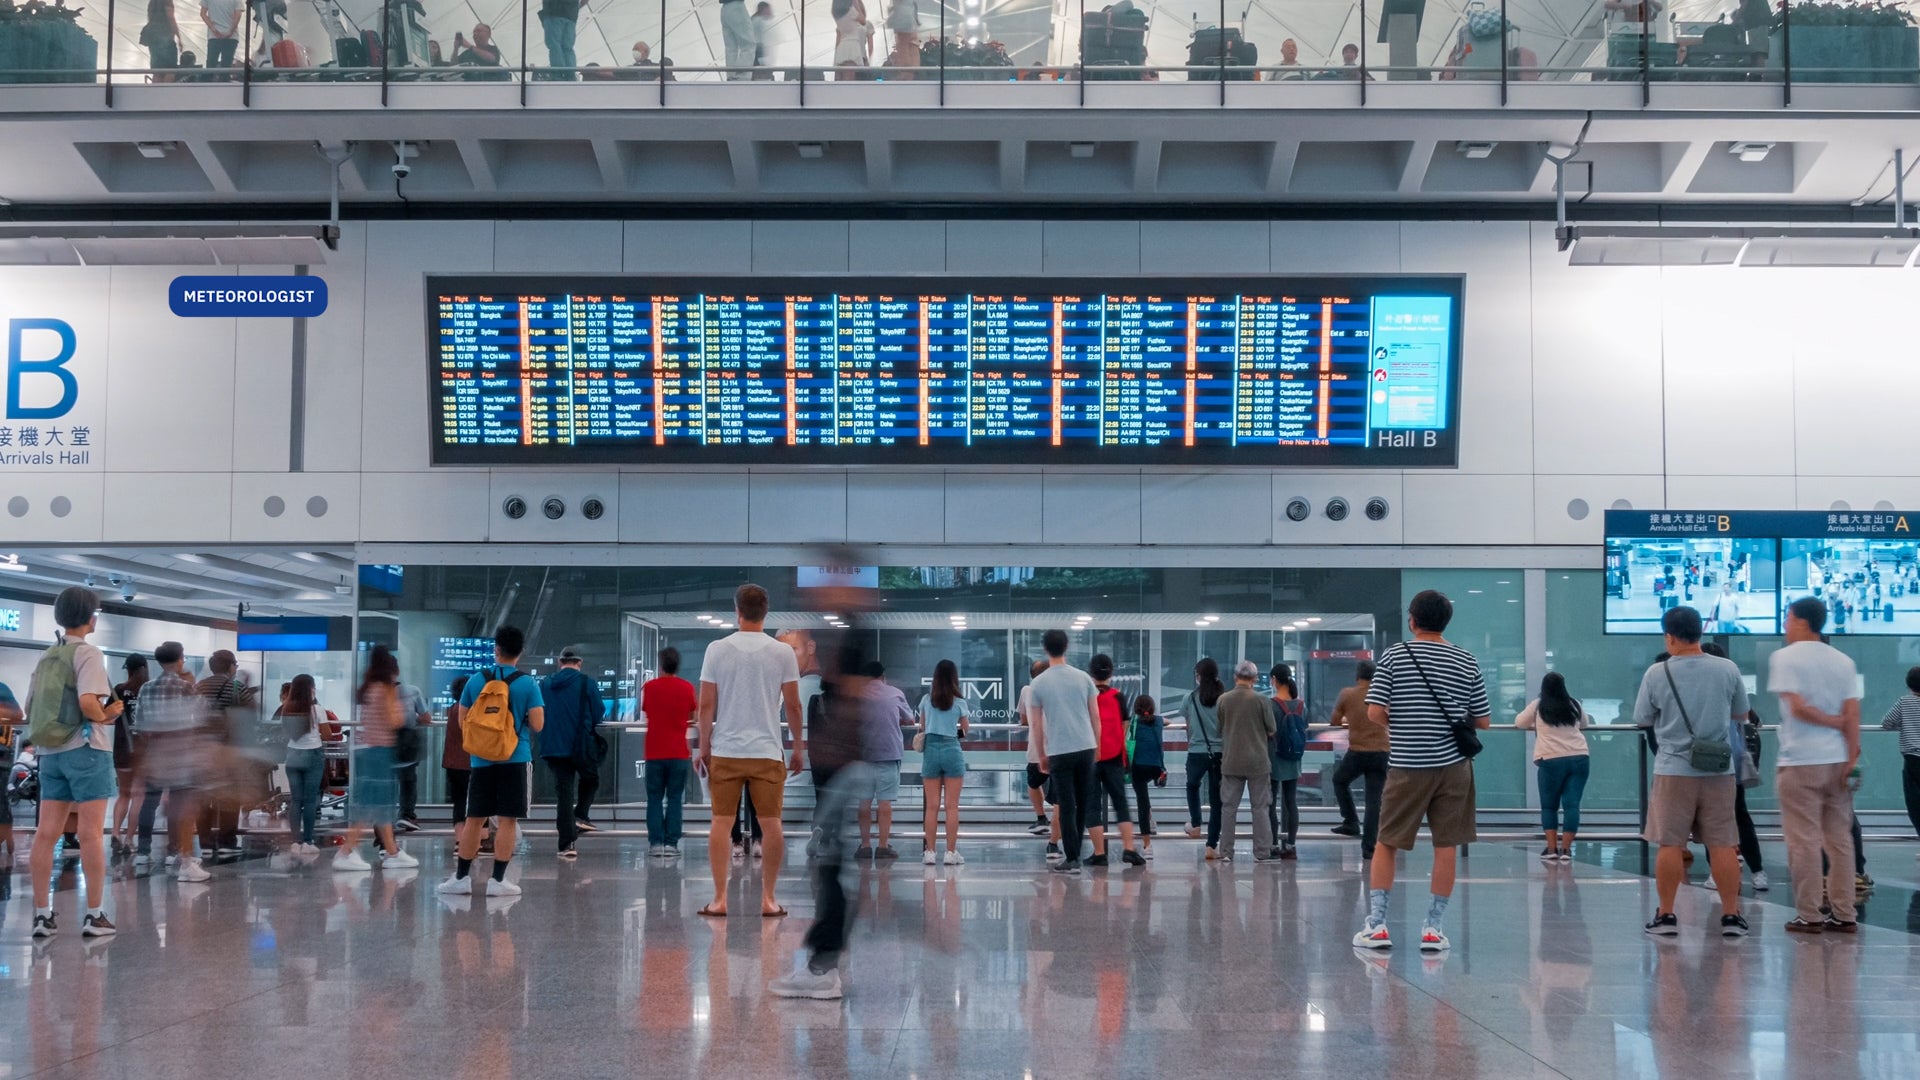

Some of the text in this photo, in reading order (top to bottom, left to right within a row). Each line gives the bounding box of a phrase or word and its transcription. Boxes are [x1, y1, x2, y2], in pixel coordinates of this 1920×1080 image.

[6, 318, 79, 420] B
[1379, 430, 1437, 447] Hall B
[60, 451, 90, 465] Hall
[1650, 514, 1717, 524] 接機大堂出口
[1718, 515, 1731, 532] B
[1827, 514, 1895, 525] 接機大堂出口
[1894, 515, 1910, 532] A
